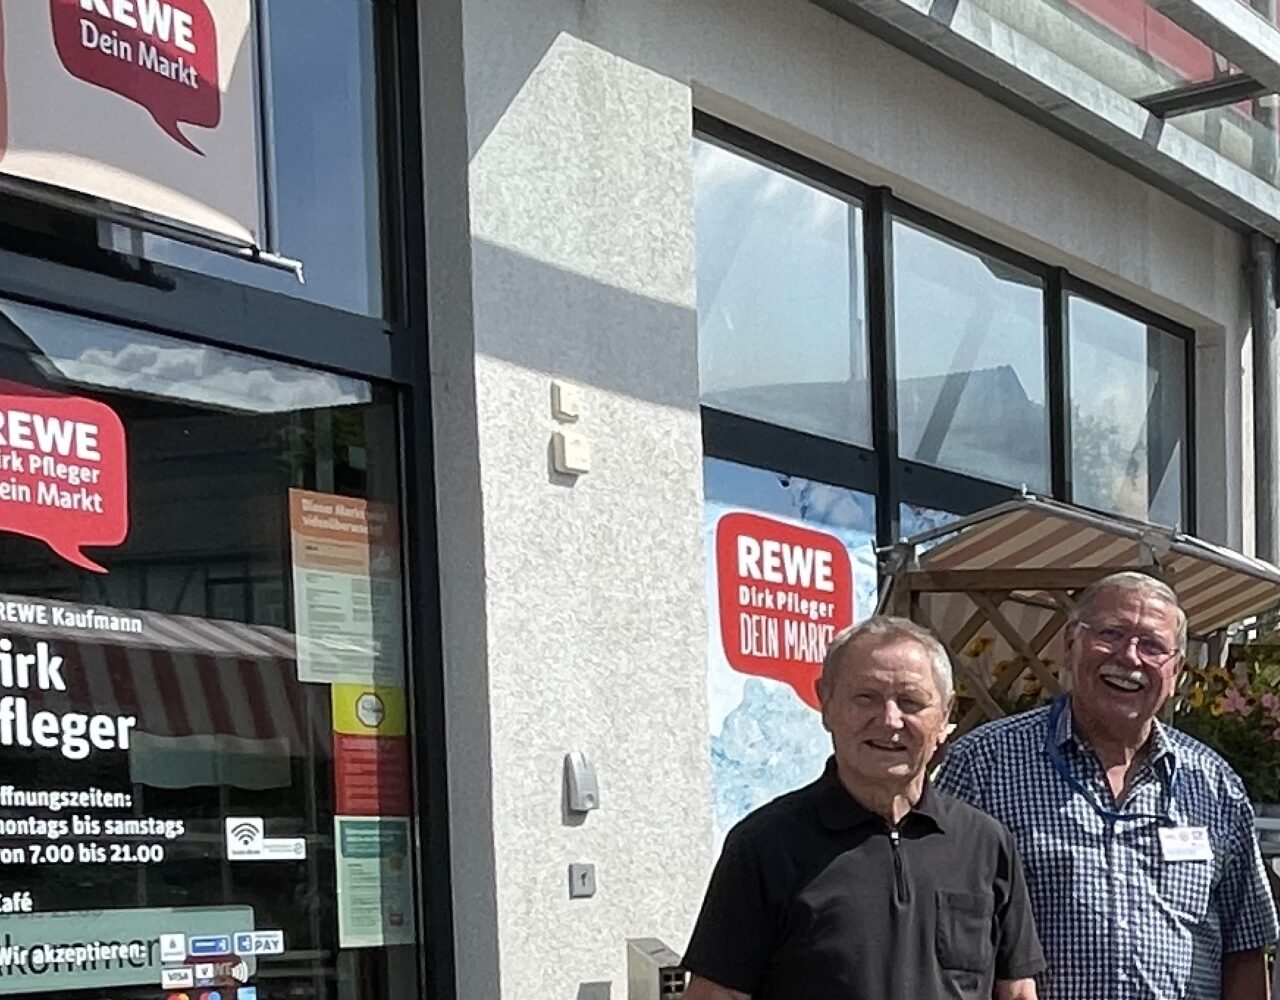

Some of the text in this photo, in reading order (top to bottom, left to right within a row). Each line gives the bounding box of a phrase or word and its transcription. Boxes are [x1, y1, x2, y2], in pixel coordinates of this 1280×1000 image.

[80, 18, 199, 89] Dein Markt
[0, 410, 101, 462] EWE
[0, 450, 100, 486] rk Pfleger
[0, 477, 104, 514] ein Markt
[737, 534, 835, 592] REWE
[51, 607, 143, 633] Kaufmann
[738, 585, 835, 621] Dirk Pfleger
[739, 612, 836, 664] DEIN MARKT
[0, 638, 66, 691] irk
[0, 695, 137, 760] fleger
[0, 785, 132, 811] ffnungszeiten:
[72, 814, 101, 835] bis
[104, 817, 185, 839] samstags
[0, 842, 164, 865] on 7.00 bis 21.00
[0, 891, 33, 913] afé
[32, 940, 147, 966] akzeptieren:
[254, 939, 280, 952] PAY
